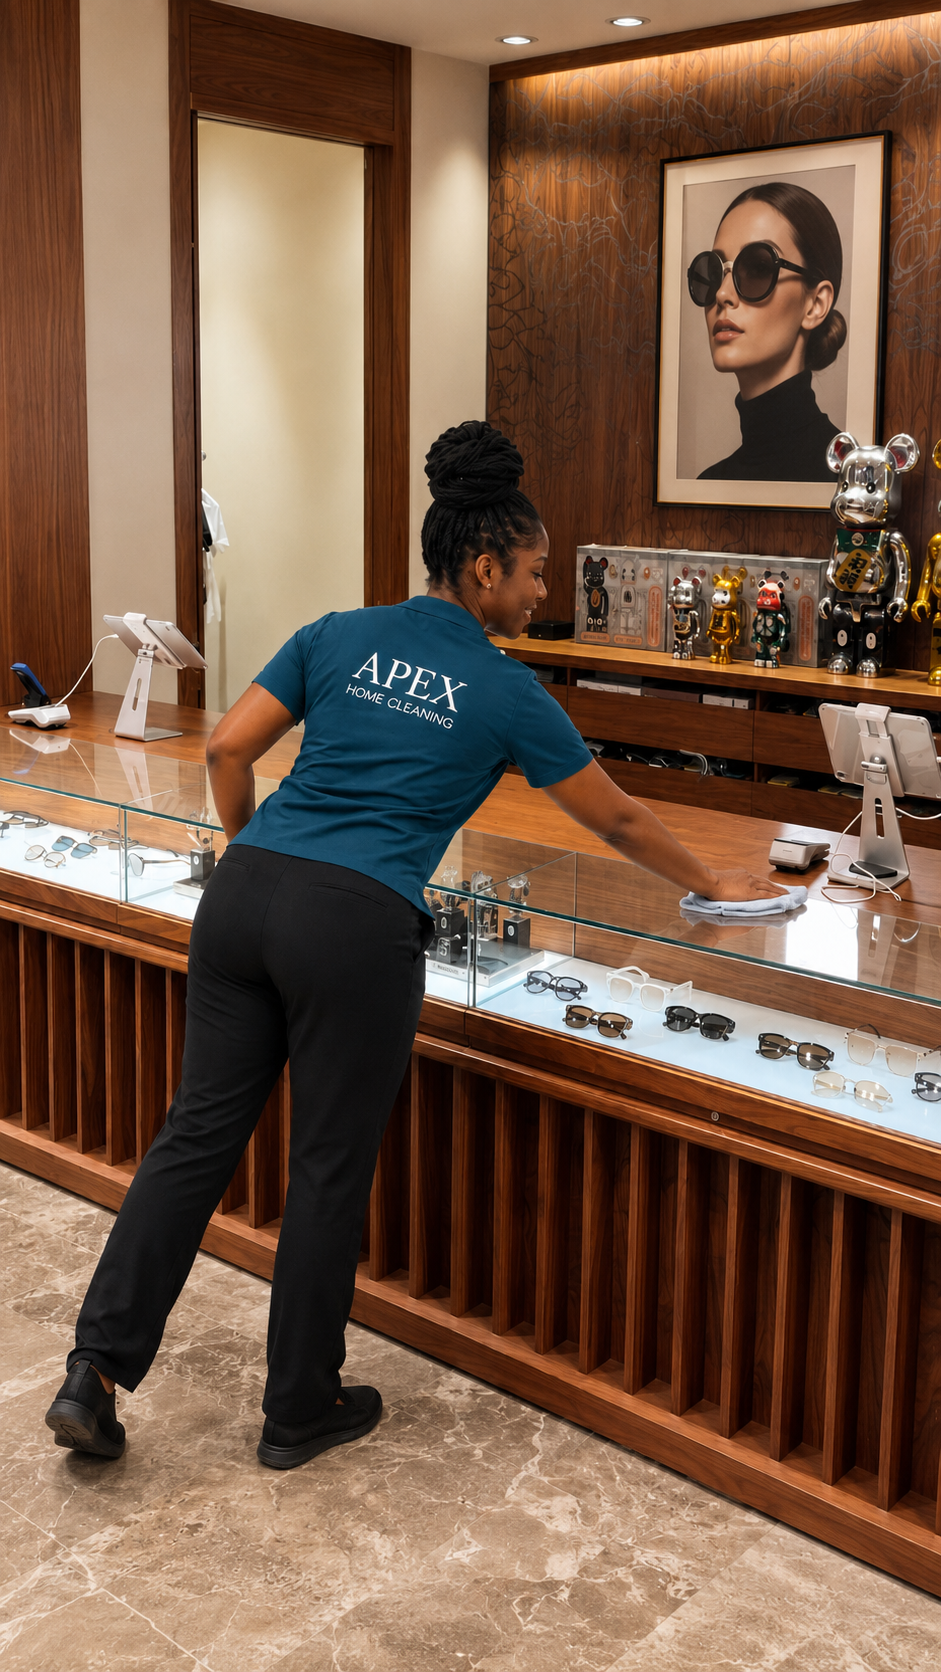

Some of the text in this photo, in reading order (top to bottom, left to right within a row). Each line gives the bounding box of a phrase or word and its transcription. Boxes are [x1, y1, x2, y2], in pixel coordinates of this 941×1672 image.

[345, 683, 454, 730] HOME CLEANING
[352, 652, 468, 713] APEX
